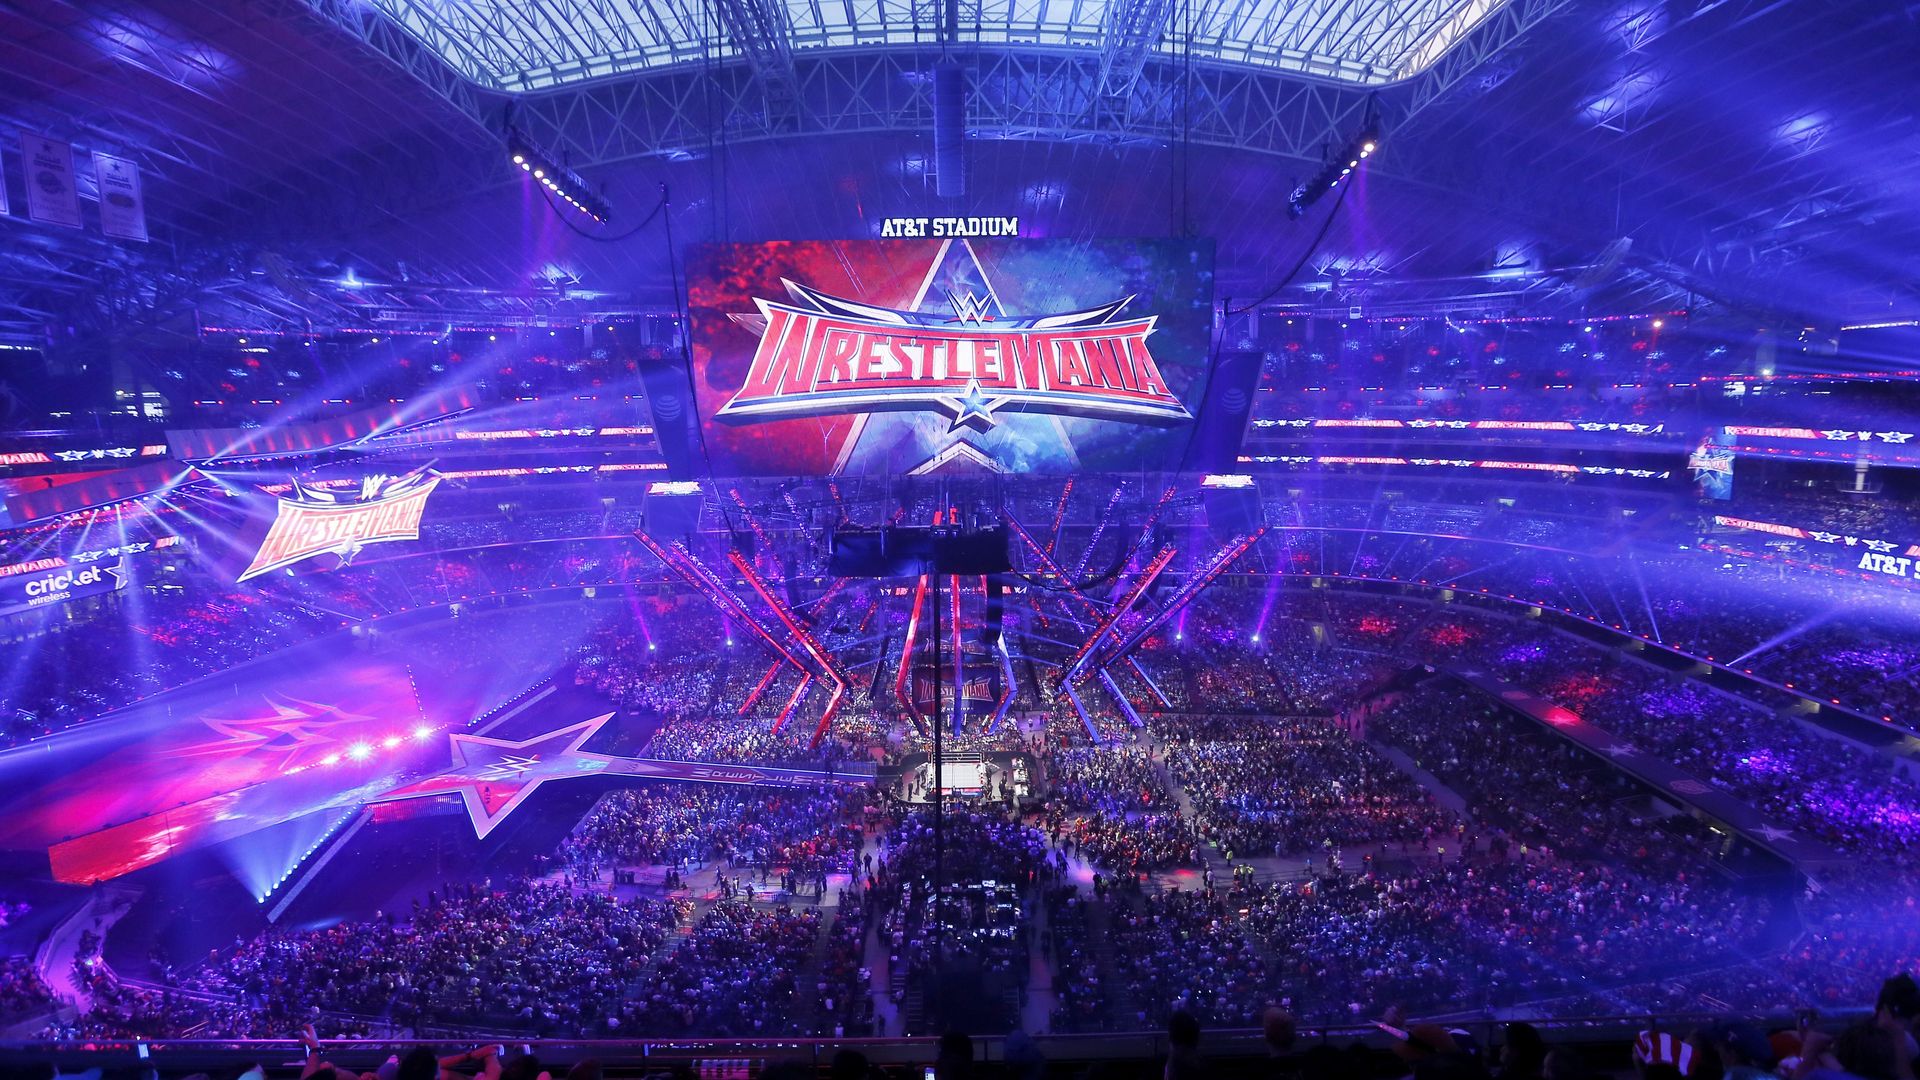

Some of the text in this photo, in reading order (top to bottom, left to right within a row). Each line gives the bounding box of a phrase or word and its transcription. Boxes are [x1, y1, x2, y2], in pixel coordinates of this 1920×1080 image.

[881, 217, 1018, 237] AT&T STADIUM
[735, 312, 1173, 402] WRESTLEMANIA
[251, 497, 425, 571] WRESTLEMANIA
[1858, 552, 1911, 577] AT&T
[25, 565, 102, 595] cricket
[28, 591, 71, 606] wireless
